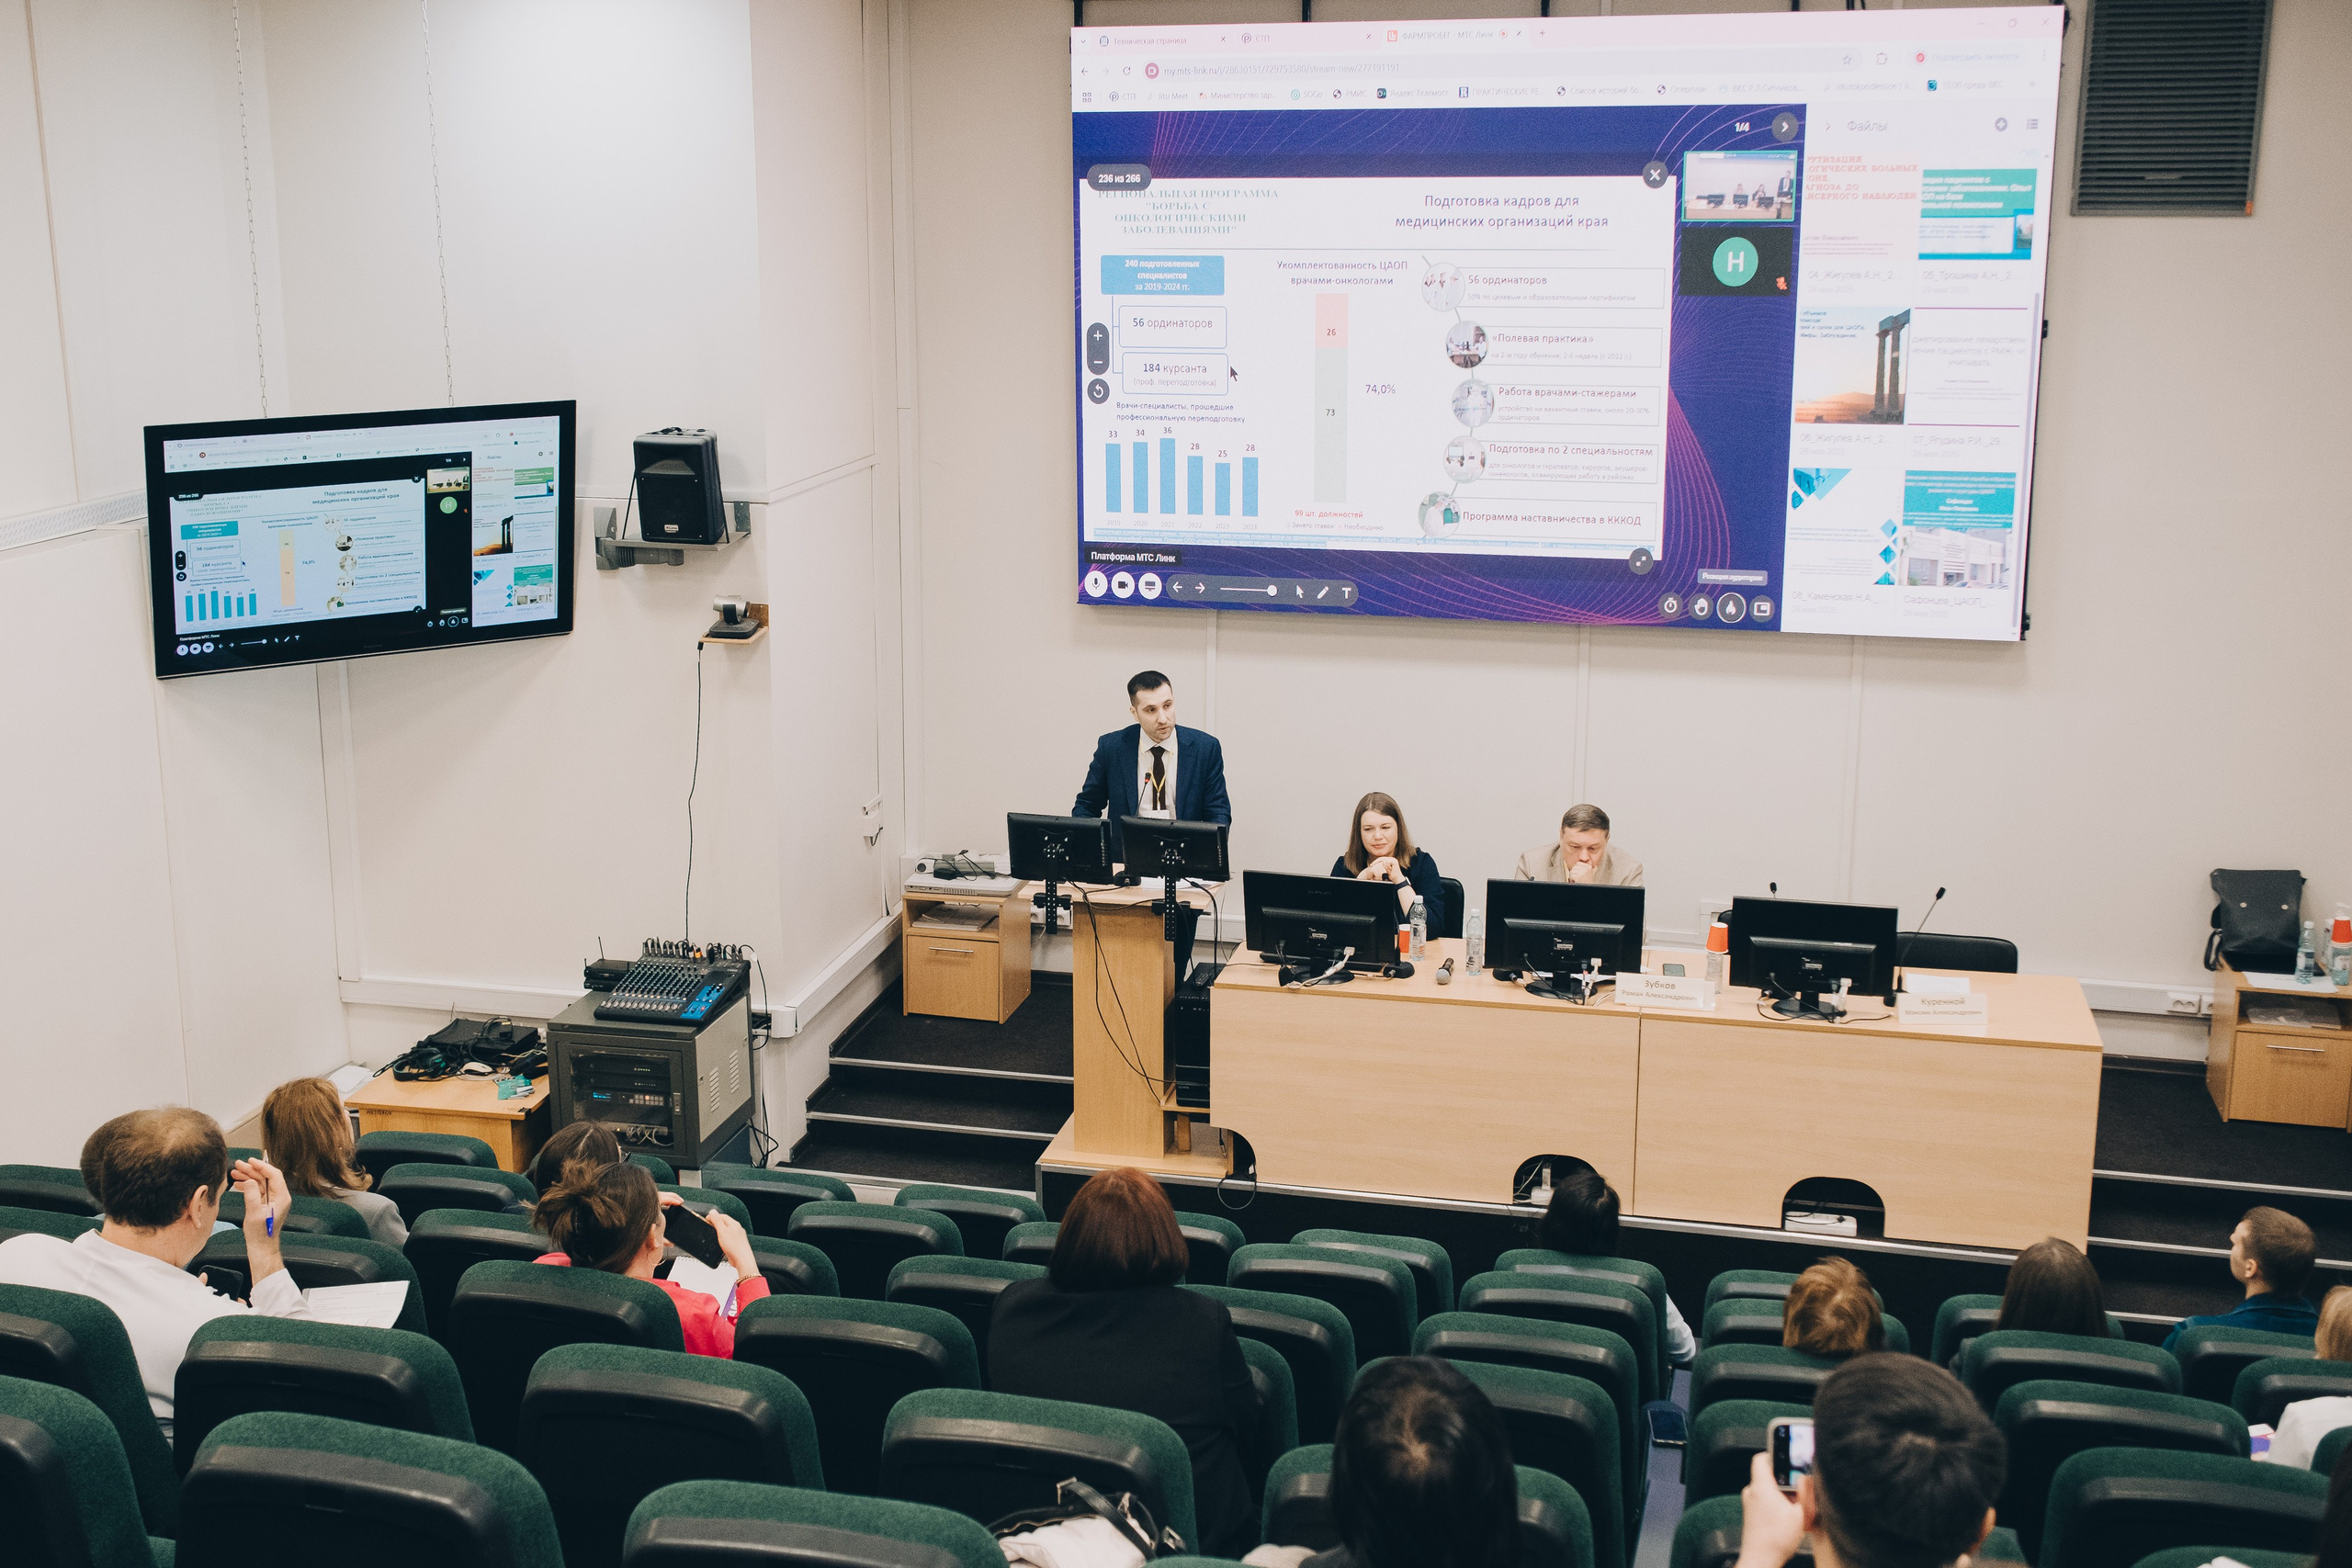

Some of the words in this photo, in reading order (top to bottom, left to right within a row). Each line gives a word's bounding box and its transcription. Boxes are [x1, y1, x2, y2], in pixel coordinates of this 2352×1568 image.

[1255, 34, 1270, 42] СТП
[1402, 30, 1451, 40] ФАРМПРОБЕГ
[1458, 30, 1473, 39] МТС
[1474, 30, 1494, 39] Линк
[1114, 37, 1155, 45] Техническая
[1157, 36, 1187, 46] страница
[1390, 89, 1414, 98] Яндекс
[1416, 88, 1449, 97] Телемост
[1472, 87, 1528, 96] ПРАКТИЧЕСКИЕ
[1570, 86, 1596, 96] Список
[1598, 85, 1627, 96] историй
[1122, 93, 1136, 101] СТП
[1158, 92, 1170, 100] Jitsi
[1171, 92, 1188, 100] Meet
[1210, 92, 1259, 101] Министерство
[1847, 118, 1888, 131] Файлы
[1098, 175, 1114, 184] 236
[1125, 175, 1141, 184] 266
[1098, 189, 1196, 198] РЕГИОНАЛЬНАЯ
[1201, 189, 1279, 198] ПРОГРАММА
[1146, 202, 1198, 210] "БОРЬБА
[1202, 202, 1212, 210] С
[1424, 196, 1499, 209] Подготовка
[1504, 197, 1551, 209] кадров
[1555, 197, 1579, 209] для
[1114, 213, 1246, 222] ОНКОЛОГИЧЕСКИМИ
[1396, 218, 1484, 230] медицинских
[1488, 214, 1574, 230] организаций
[1577, 218, 1609, 230] края
[1124, 225, 1237, 234] ЗАБОЛЕВАНИЯМИ"
[1139, 260, 1200, 269] подготовленных
[1276, 260, 1376, 271] Укомплектованность
[1379, 261, 1408, 272] ЦАОП
[1727, 252, 1744, 272] Н
[1136, 272, 1187, 280] специалистов
[1468, 275, 1479, 284] 56
[1482, 276, 1547, 287] ординаторов
[1144, 282, 1180, 291] 2019-2024
[1291, 276, 1394, 287] врачами-онкологами
[1528, 293, 1588, 302] образовательным
[1589, 295, 1635, 303] сертификатам
[1133, 318, 1145, 327] 56
[1147, 319, 1213, 331] ординаторов
[1492, 333, 1539, 343] «Полевая
[1543, 334, 1594, 344] практика»
[1143, 363, 1160, 373] 184
[1163, 365, 1207, 376] курсанта
[1134, 378, 1155, 388] (проф.
[1158, 378, 1216, 389] переподготовка)
[1365, 384, 1396, 396] 74,0%
[1498, 387, 1532, 397] Работа
[1535, 389, 1636, 400] врачами-стажерами
[1116, 401, 1189, 412] Врачи-специалисты,
[1191, 404, 1234, 412] прошедшие
[1116, 413, 1186, 423] профессиональную
[1188, 415, 1246, 424] переподготовку
[1108, 430, 1118, 438] 33
[1136, 429, 1145, 437] 34
[1163, 426, 1172, 434] 36
[1191, 442, 1200, 451] 28
[1246, 444, 1256, 452] 28
[1489, 444, 1545, 456] Подготовка
[1548, 446, 1560, 455] по
[1563, 445, 1568, 454] 2
[1571, 446, 1654, 457] специальностям
[1217, 449, 1227, 457] 25
[1318, 511, 1363, 520] должностей
[1463, 512, 1518, 524] Программа
[1521, 514, 1596, 525] наставничества
[1599, 516, 1605, 525] в
[1607, 515, 1642, 527] КККОД
[1344, 524, 1384, 532] Необходимо
[1091, 551, 1136, 563] Платформа
[1136, 553, 1154, 562] МТС
[1155, 554, 1176, 563] Линк
[1645, 980, 1676, 990] Зубков
[1645, 991, 1698, 1002] Александрович
[1921, 997, 1965, 1008] Куренной
